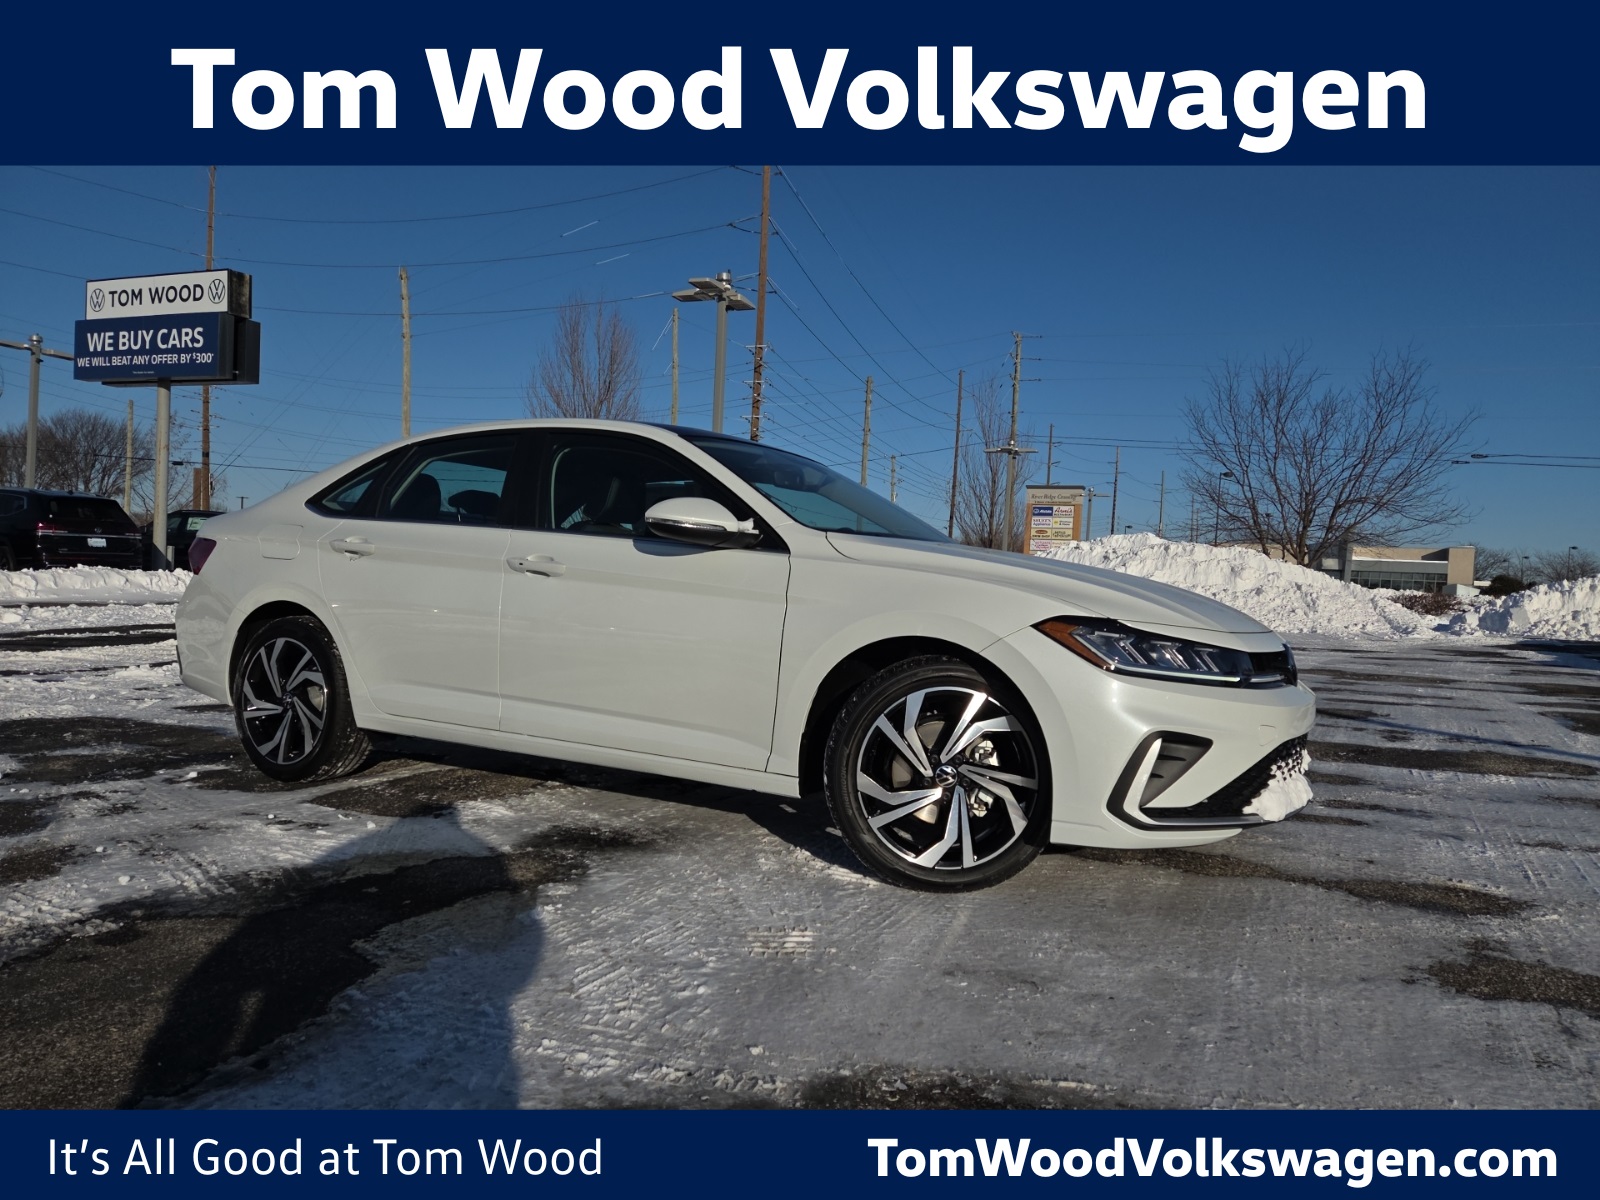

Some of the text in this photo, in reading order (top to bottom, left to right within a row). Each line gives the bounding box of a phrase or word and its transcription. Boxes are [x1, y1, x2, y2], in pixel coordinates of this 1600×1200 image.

[108, 288, 143, 308] TOM
[148, 284, 204, 305] WOOD
[87, 327, 204, 352] WE BUY CARS
[77, 357, 90, 368] WE
[91, 356, 111, 367] WILL
[111, 355, 132, 366] BEAT
[132, 354, 150, 365] ANY
[151, 353, 179, 365] OFFER
[180, 353, 192, 364] BY
